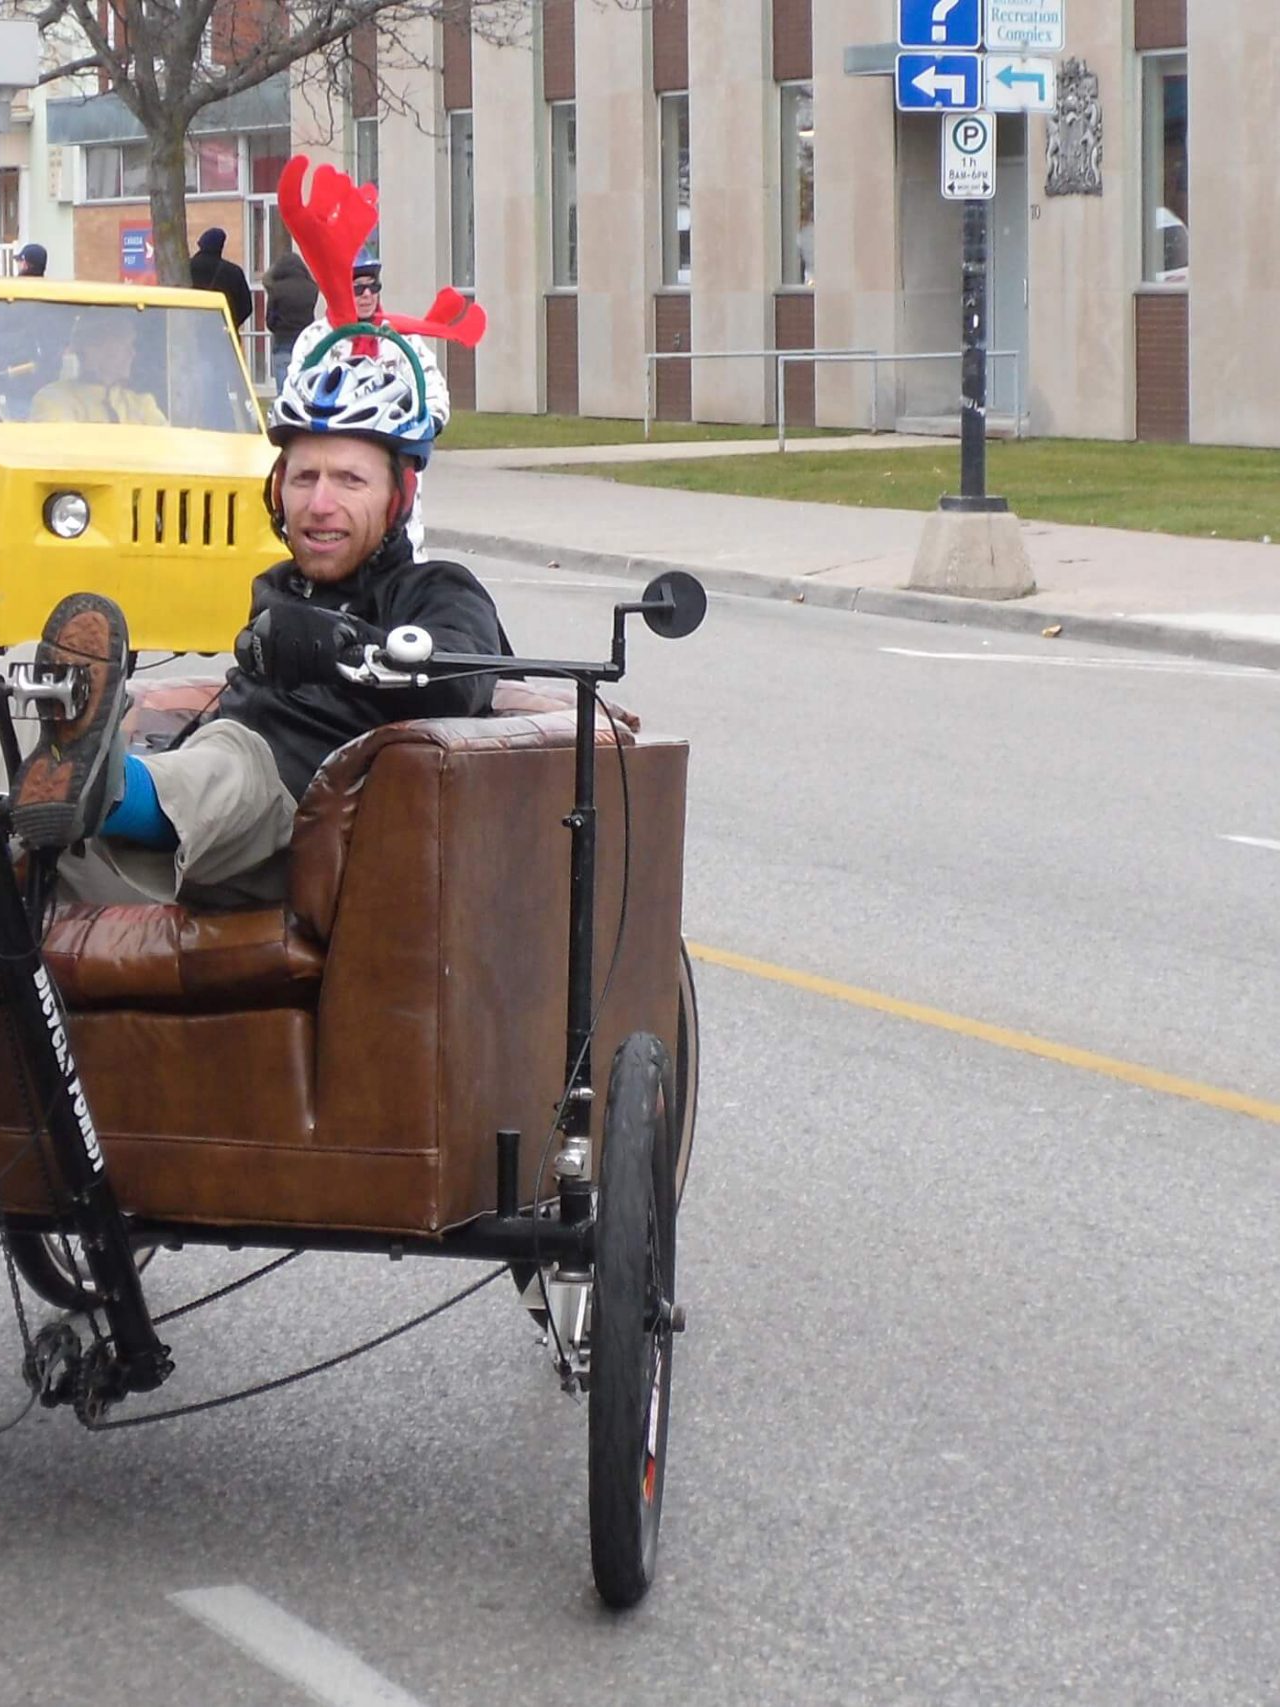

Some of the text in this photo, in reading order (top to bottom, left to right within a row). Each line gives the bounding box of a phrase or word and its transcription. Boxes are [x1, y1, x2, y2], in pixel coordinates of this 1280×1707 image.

[992, 7, 1058, 22] Recreation
[998, 25, 1052, 42] Complex
[963, 126, 979, 146] P
